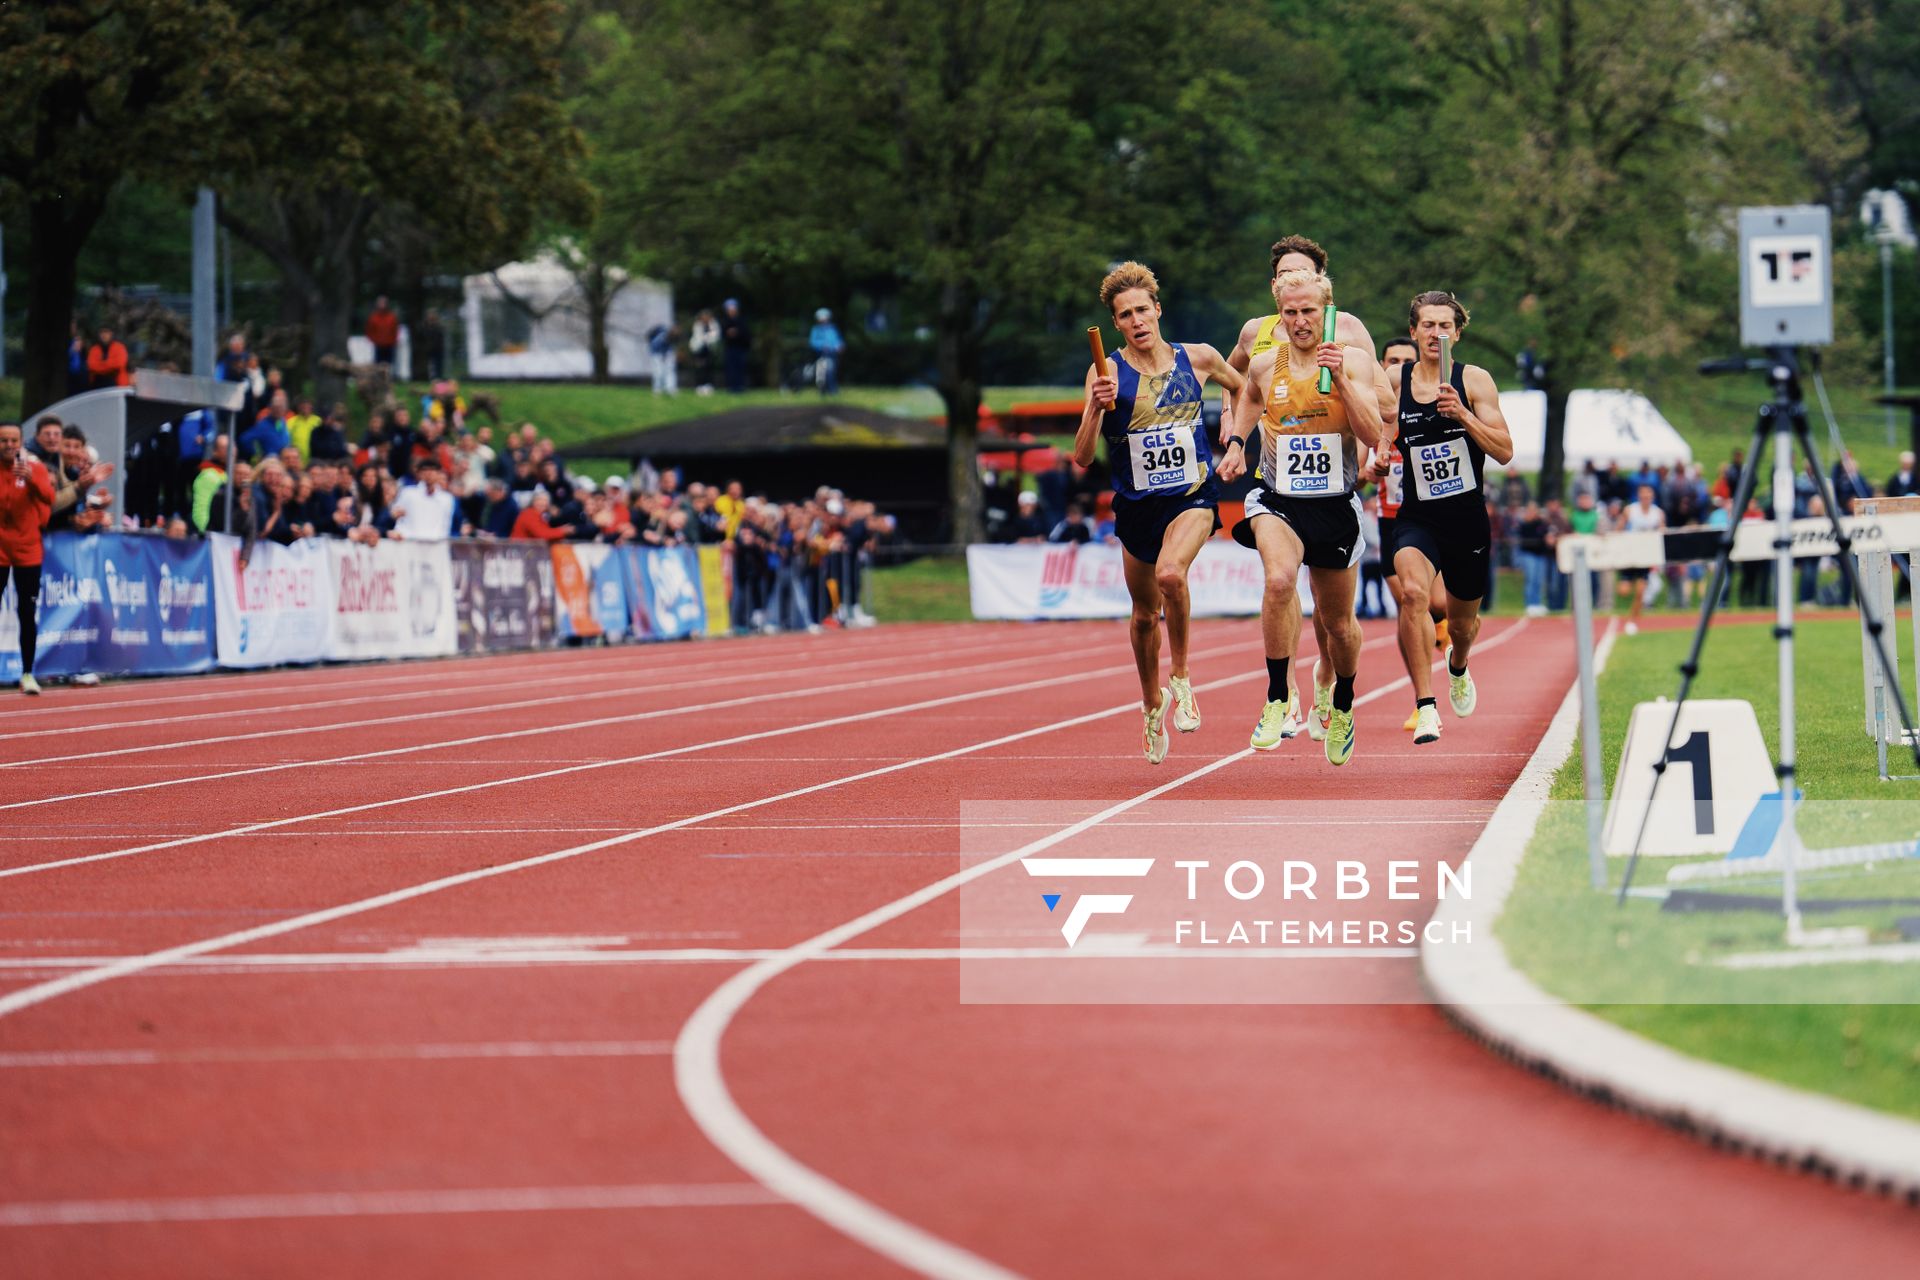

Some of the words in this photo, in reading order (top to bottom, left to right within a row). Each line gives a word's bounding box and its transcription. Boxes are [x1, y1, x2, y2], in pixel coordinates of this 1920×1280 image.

[1142, 446, 1186, 471] 349
[1287, 452, 1331, 475] 248
[1421, 456, 1460, 482] 587
[1667, 731, 1715, 835] 1
